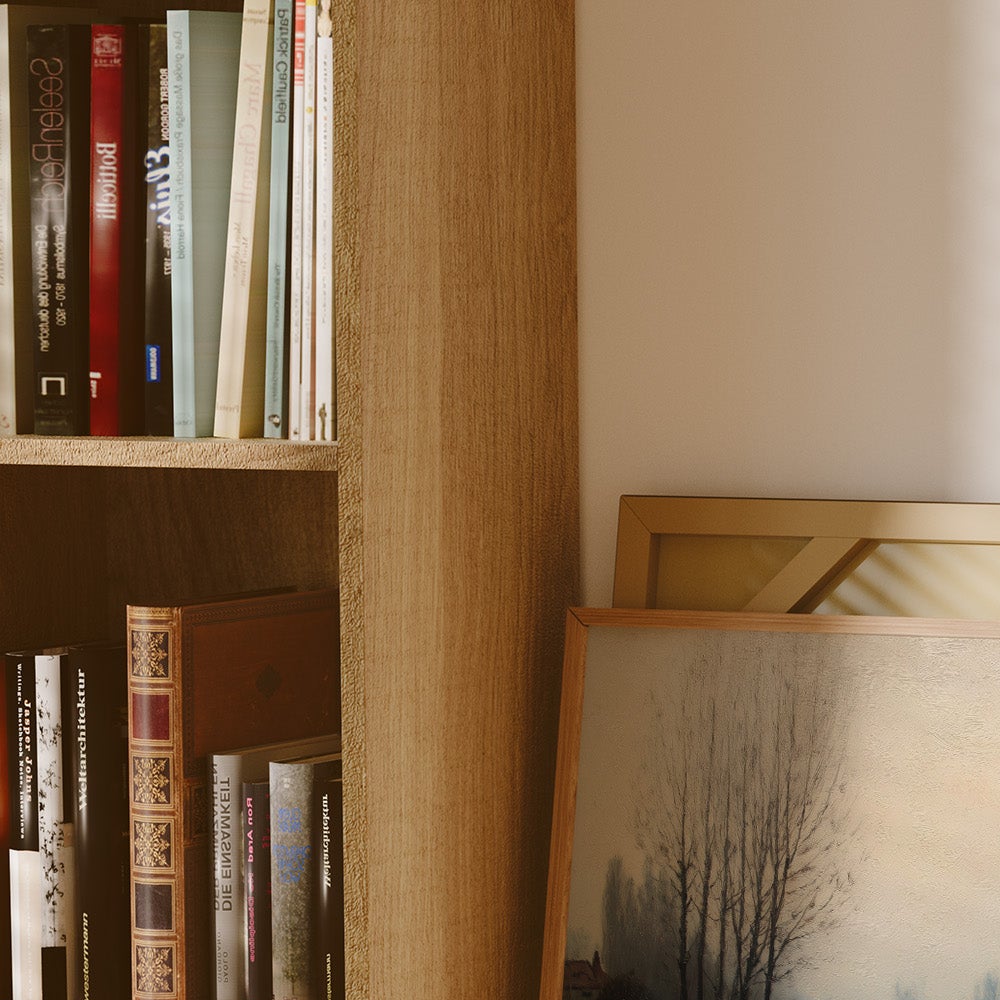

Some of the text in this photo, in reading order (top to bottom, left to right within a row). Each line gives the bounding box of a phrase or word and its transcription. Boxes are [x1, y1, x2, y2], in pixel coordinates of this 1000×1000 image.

[23, 699, 34, 804] Jasper Johns
[75, 668, 88, 811] Weltarchitektur
